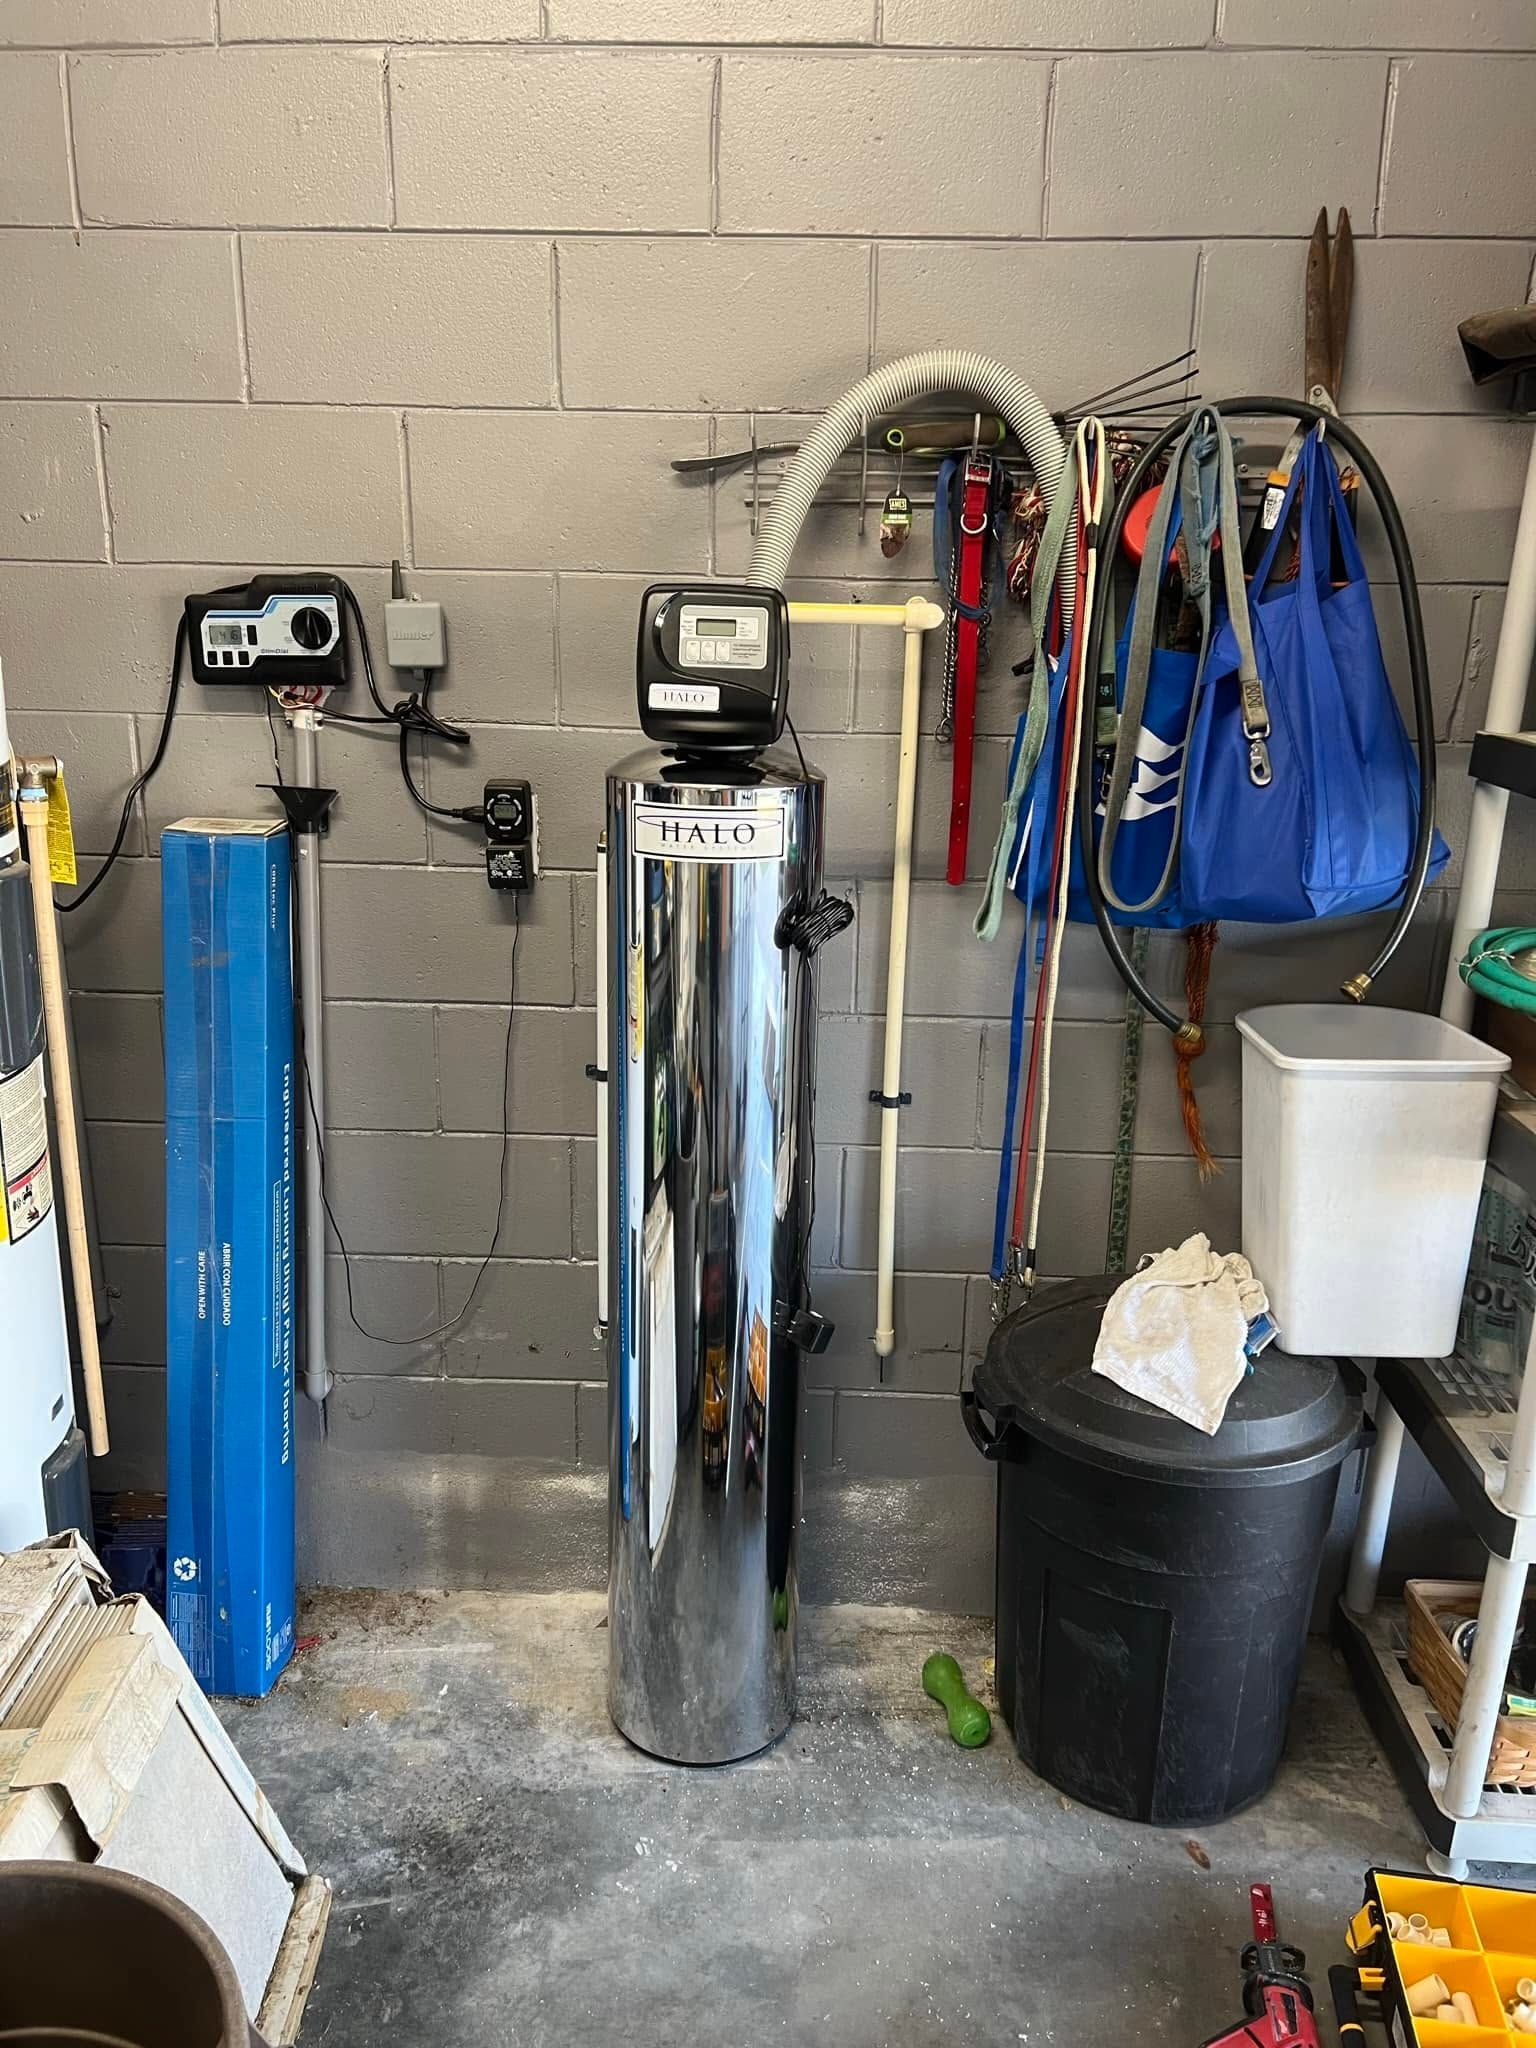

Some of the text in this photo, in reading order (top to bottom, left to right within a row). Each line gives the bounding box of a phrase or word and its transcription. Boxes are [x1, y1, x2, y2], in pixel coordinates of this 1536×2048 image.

[664, 691, 705, 703] HALO
[661, 821, 755, 845] HALO
[282, 1186, 290, 1260] Luxury
[198, 1251, 206, 1319] OPEN WITH CARE
[222, 1242, 231, 1326] ABRIR CON CUIDADO
[281, 1377, 290, 1465] Flooring
